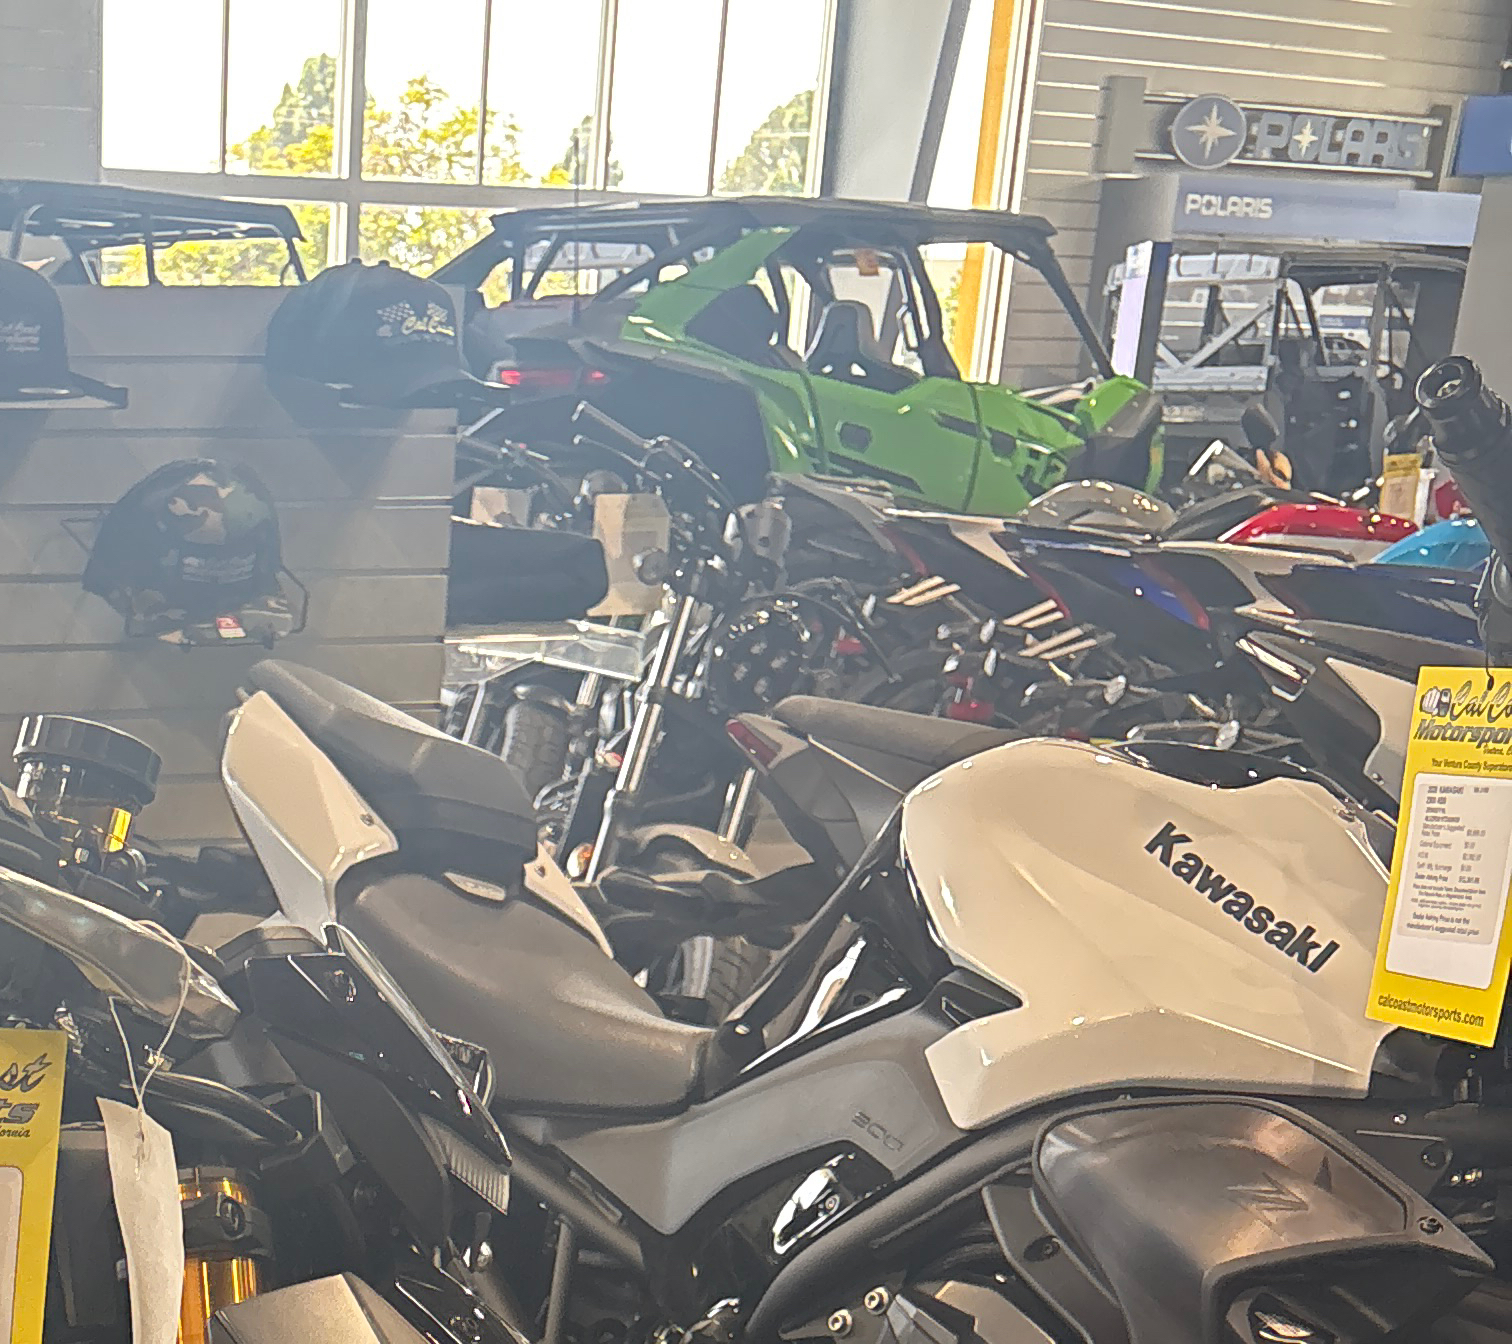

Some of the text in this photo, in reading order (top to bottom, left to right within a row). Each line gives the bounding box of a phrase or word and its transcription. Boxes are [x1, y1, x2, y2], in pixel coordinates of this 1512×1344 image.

[1256, 111, 1430, 171] POLARIS
[1185, 193, 1273, 219] POLARIS
[1144, 821, 1341, 973] Kawasaki
[1377, 994, 1485, 1027] calcoastmotorsports.com
